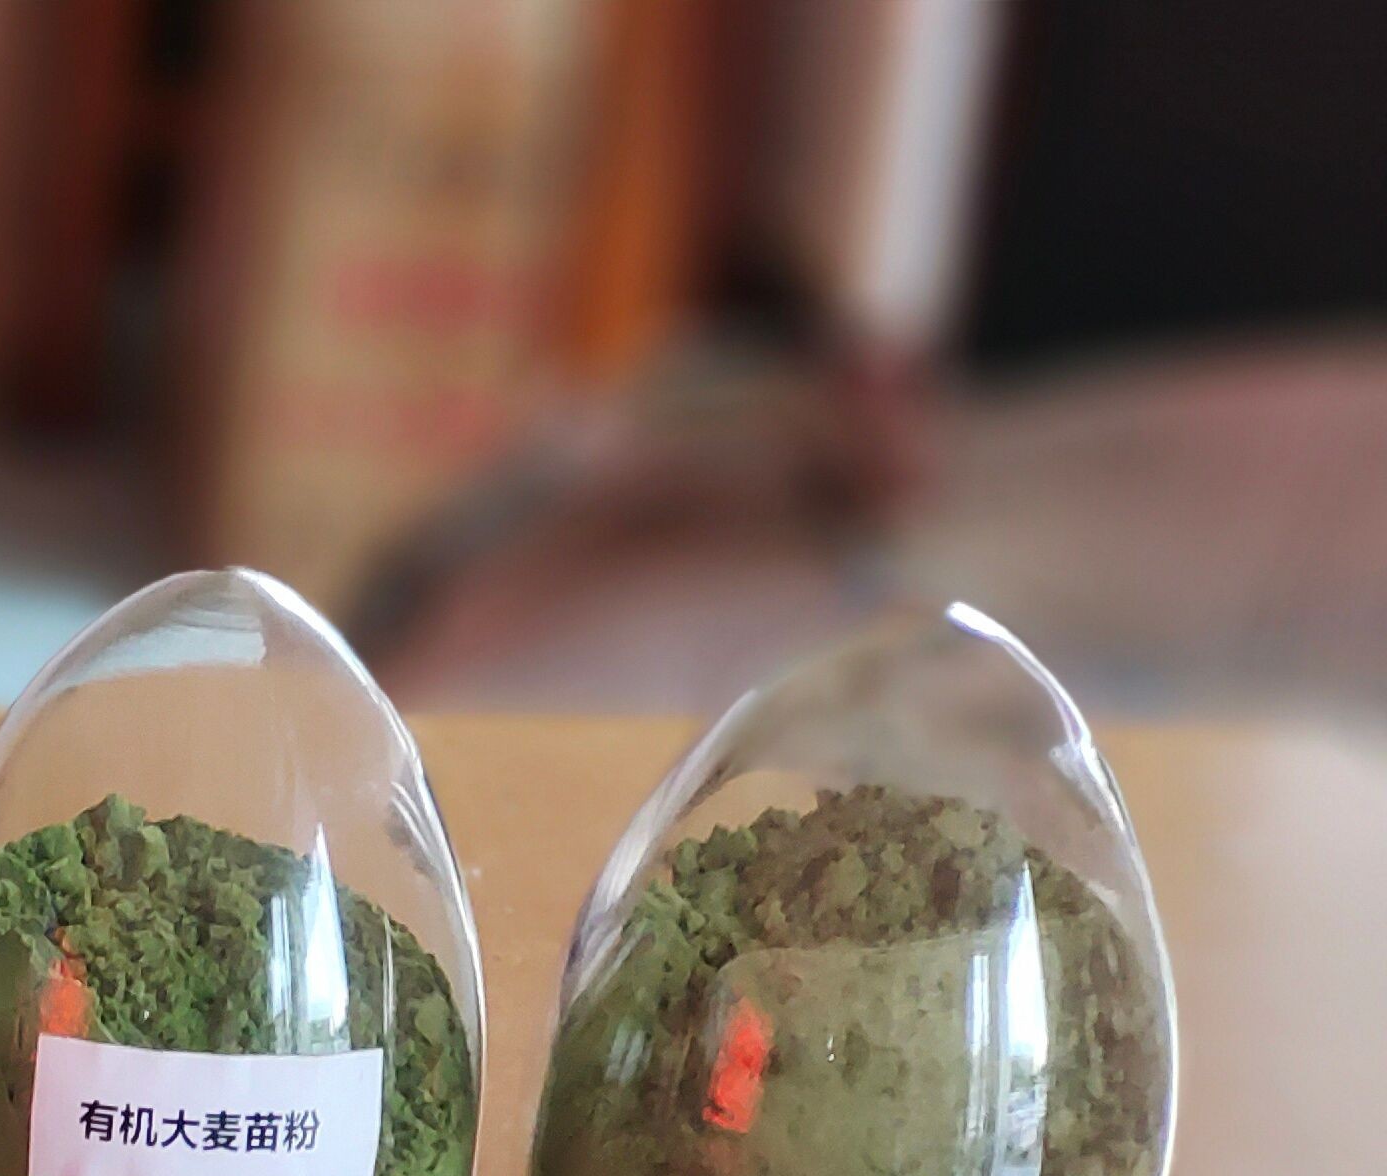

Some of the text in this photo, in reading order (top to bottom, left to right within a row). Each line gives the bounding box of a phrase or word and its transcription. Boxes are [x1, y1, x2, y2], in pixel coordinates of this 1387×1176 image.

[78, 1099, 321, 1153] 有机大麦苗粉
